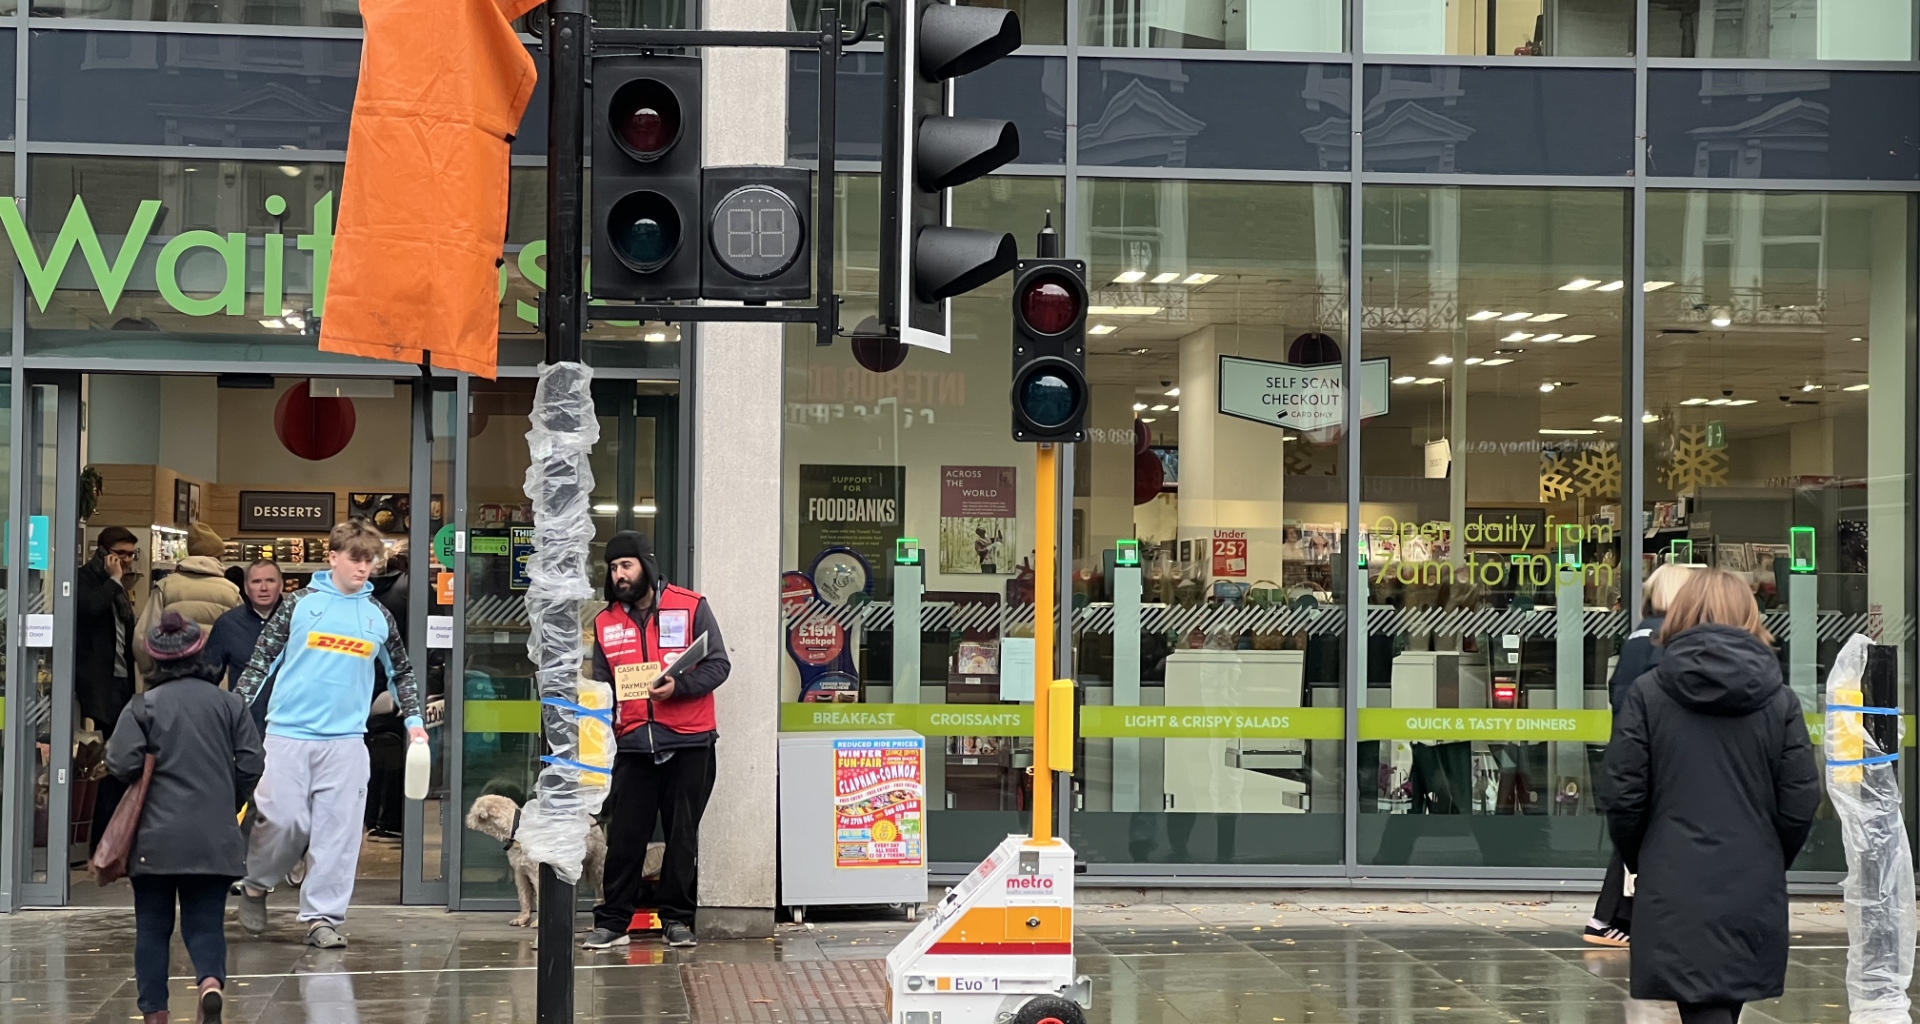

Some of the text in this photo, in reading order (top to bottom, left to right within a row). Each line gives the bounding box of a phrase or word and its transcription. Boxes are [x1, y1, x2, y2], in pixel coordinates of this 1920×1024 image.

[1266, 377, 1340, 389] SELF SCAN
[1261, 393, 1340, 406] CHECKOUT
[832, 476, 873, 484] SUPPORT
[945, 470, 982, 478] ACROSS
[946, 479, 964, 487] THE
[962, 489, 997, 497] WORLD
[253, 505, 322, 518] DESSERTS
[808, 498, 896, 523] FOODBANKS
[1213, 529, 1246, 539] Under
[1374, 515, 1454, 548] Open
[1464, 513, 1536, 552] daily
[1544, 515, 1614, 544] from
[1214, 540, 1246, 556] 25?
[1374, 550, 1614, 598] 7am to 10pm
[799, 625, 836, 637] £15M
[317, 636, 364, 654] DHL
[799, 637, 836, 647] Jackpot
[813, 712, 895, 725] BREAKFAST
[930, 713, 1021, 726] CROISSANTS
[1125, 715, 1290, 728] LIGHT & CRISPY SALADS
[1406, 718, 1576, 731] QUICK & TASTY DINNERS
[838, 750, 882, 758] WINTER
[884, 808, 896, 817] Sun
[895, 803, 906, 812] 4th
[906, 801, 918, 810] JAN
[840, 816, 850, 825] Sat
[850, 817, 863, 825] 27th
[863, 814, 874, 823] DEC
[1007, 875, 1053, 888] metro
[991, 977, 999, 991] 1
